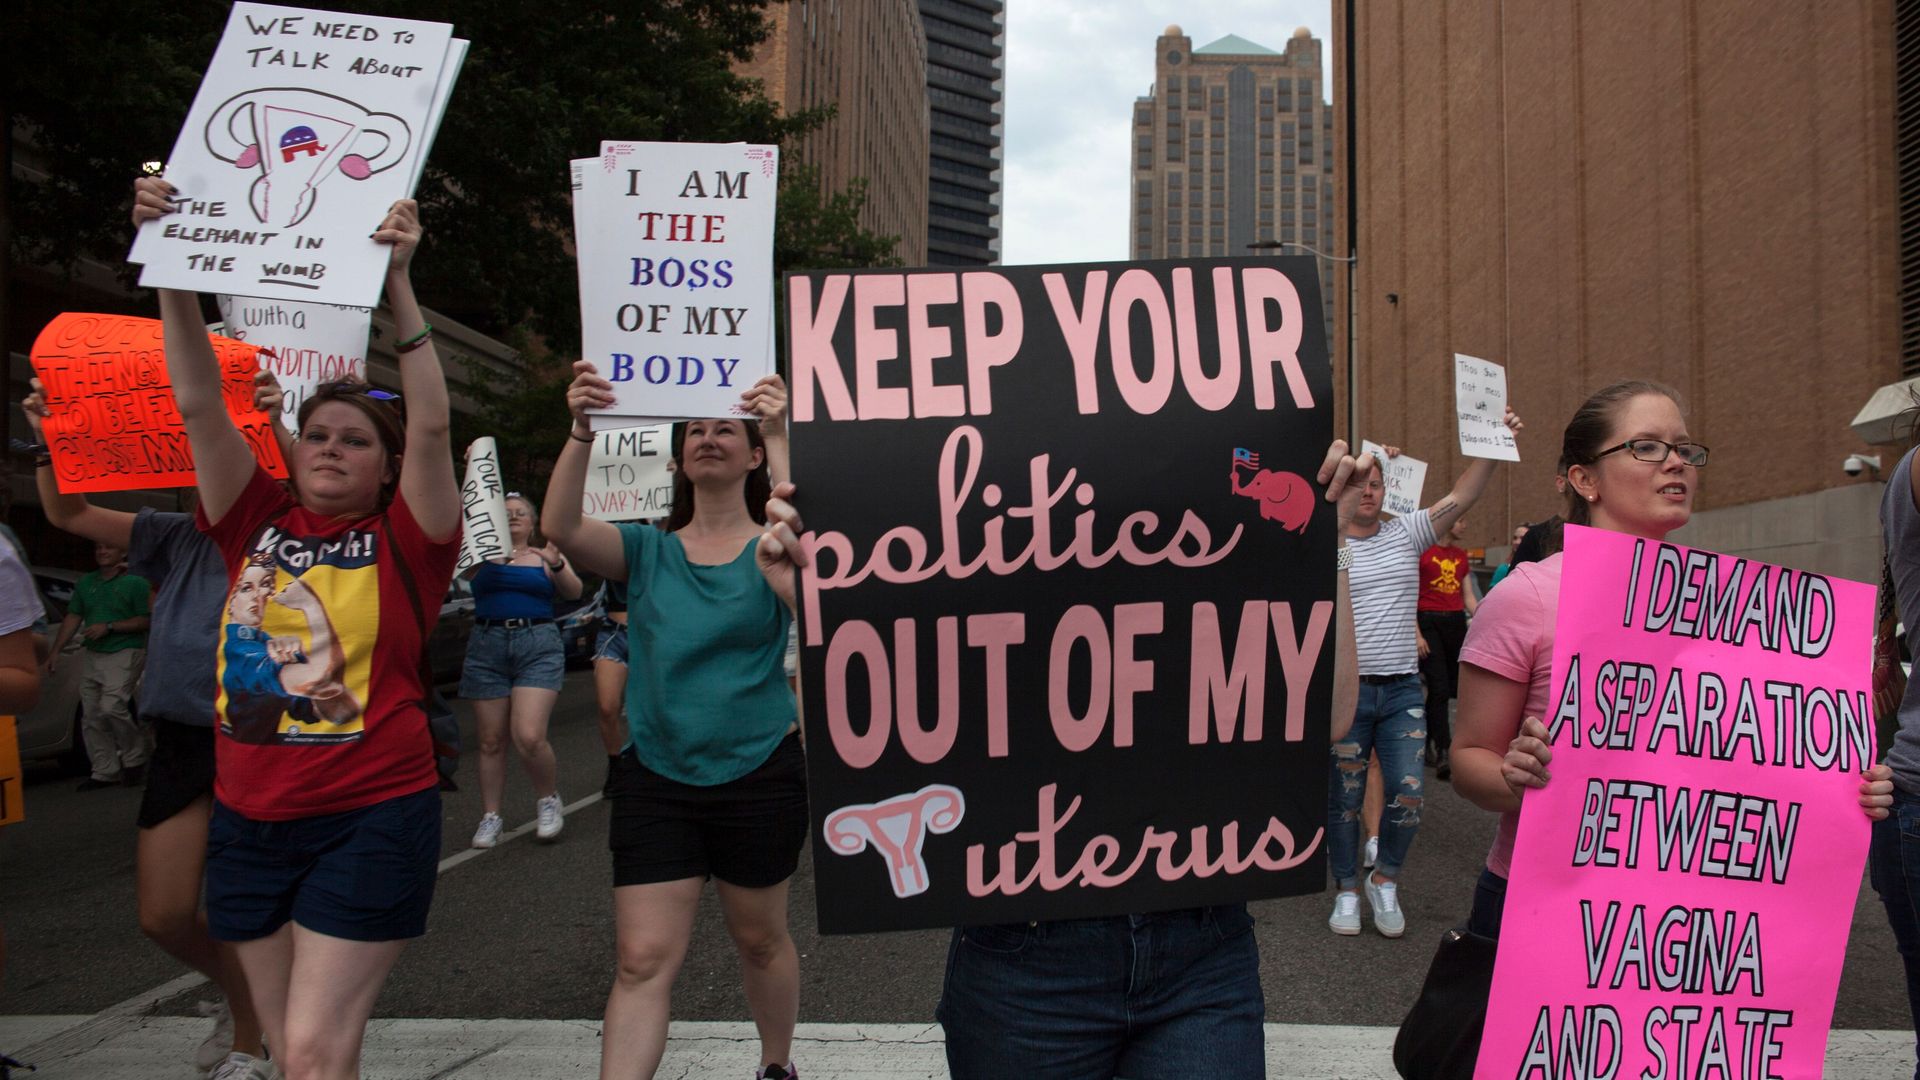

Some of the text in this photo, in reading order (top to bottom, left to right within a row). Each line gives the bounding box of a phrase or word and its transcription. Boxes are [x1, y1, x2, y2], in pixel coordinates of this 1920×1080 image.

[246, 15, 415, 45] WE NEED TO
[247, 46, 423, 79] TALK ABOUT
[625, 169, 750, 199] I AM
[173, 198, 227, 217] THE
[163, 224, 324, 250] ELEPHANT IN
[638, 212, 726, 243] THE
[187, 254, 236, 273] THE
[630, 257, 734, 290] BOSS
[292, 309, 306, 329] a
[616, 303, 748, 336] OF MY
[789, 266, 1315, 422] KEEP YOUR
[609, 353, 740, 387] BODY
[44, 400, 92, 434] TO
[473, 451, 501, 499] YOUR
[598, 463, 635, 487] TO
[463, 480, 504, 561] POLITICAL
[801, 424, 1244, 646] politics
[1623, 538, 1836, 658] I DEMAND
[824, 600, 1334, 769] OUT OF MY
[1550, 652, 1872, 773] A SEPARATION
[966, 783, 1325, 897] uterus
[1572, 778, 1802, 885] BETWEEN
[1579, 899, 1764, 996] VAGINA
[1515, 1004, 1793, 1080] AND STATE
